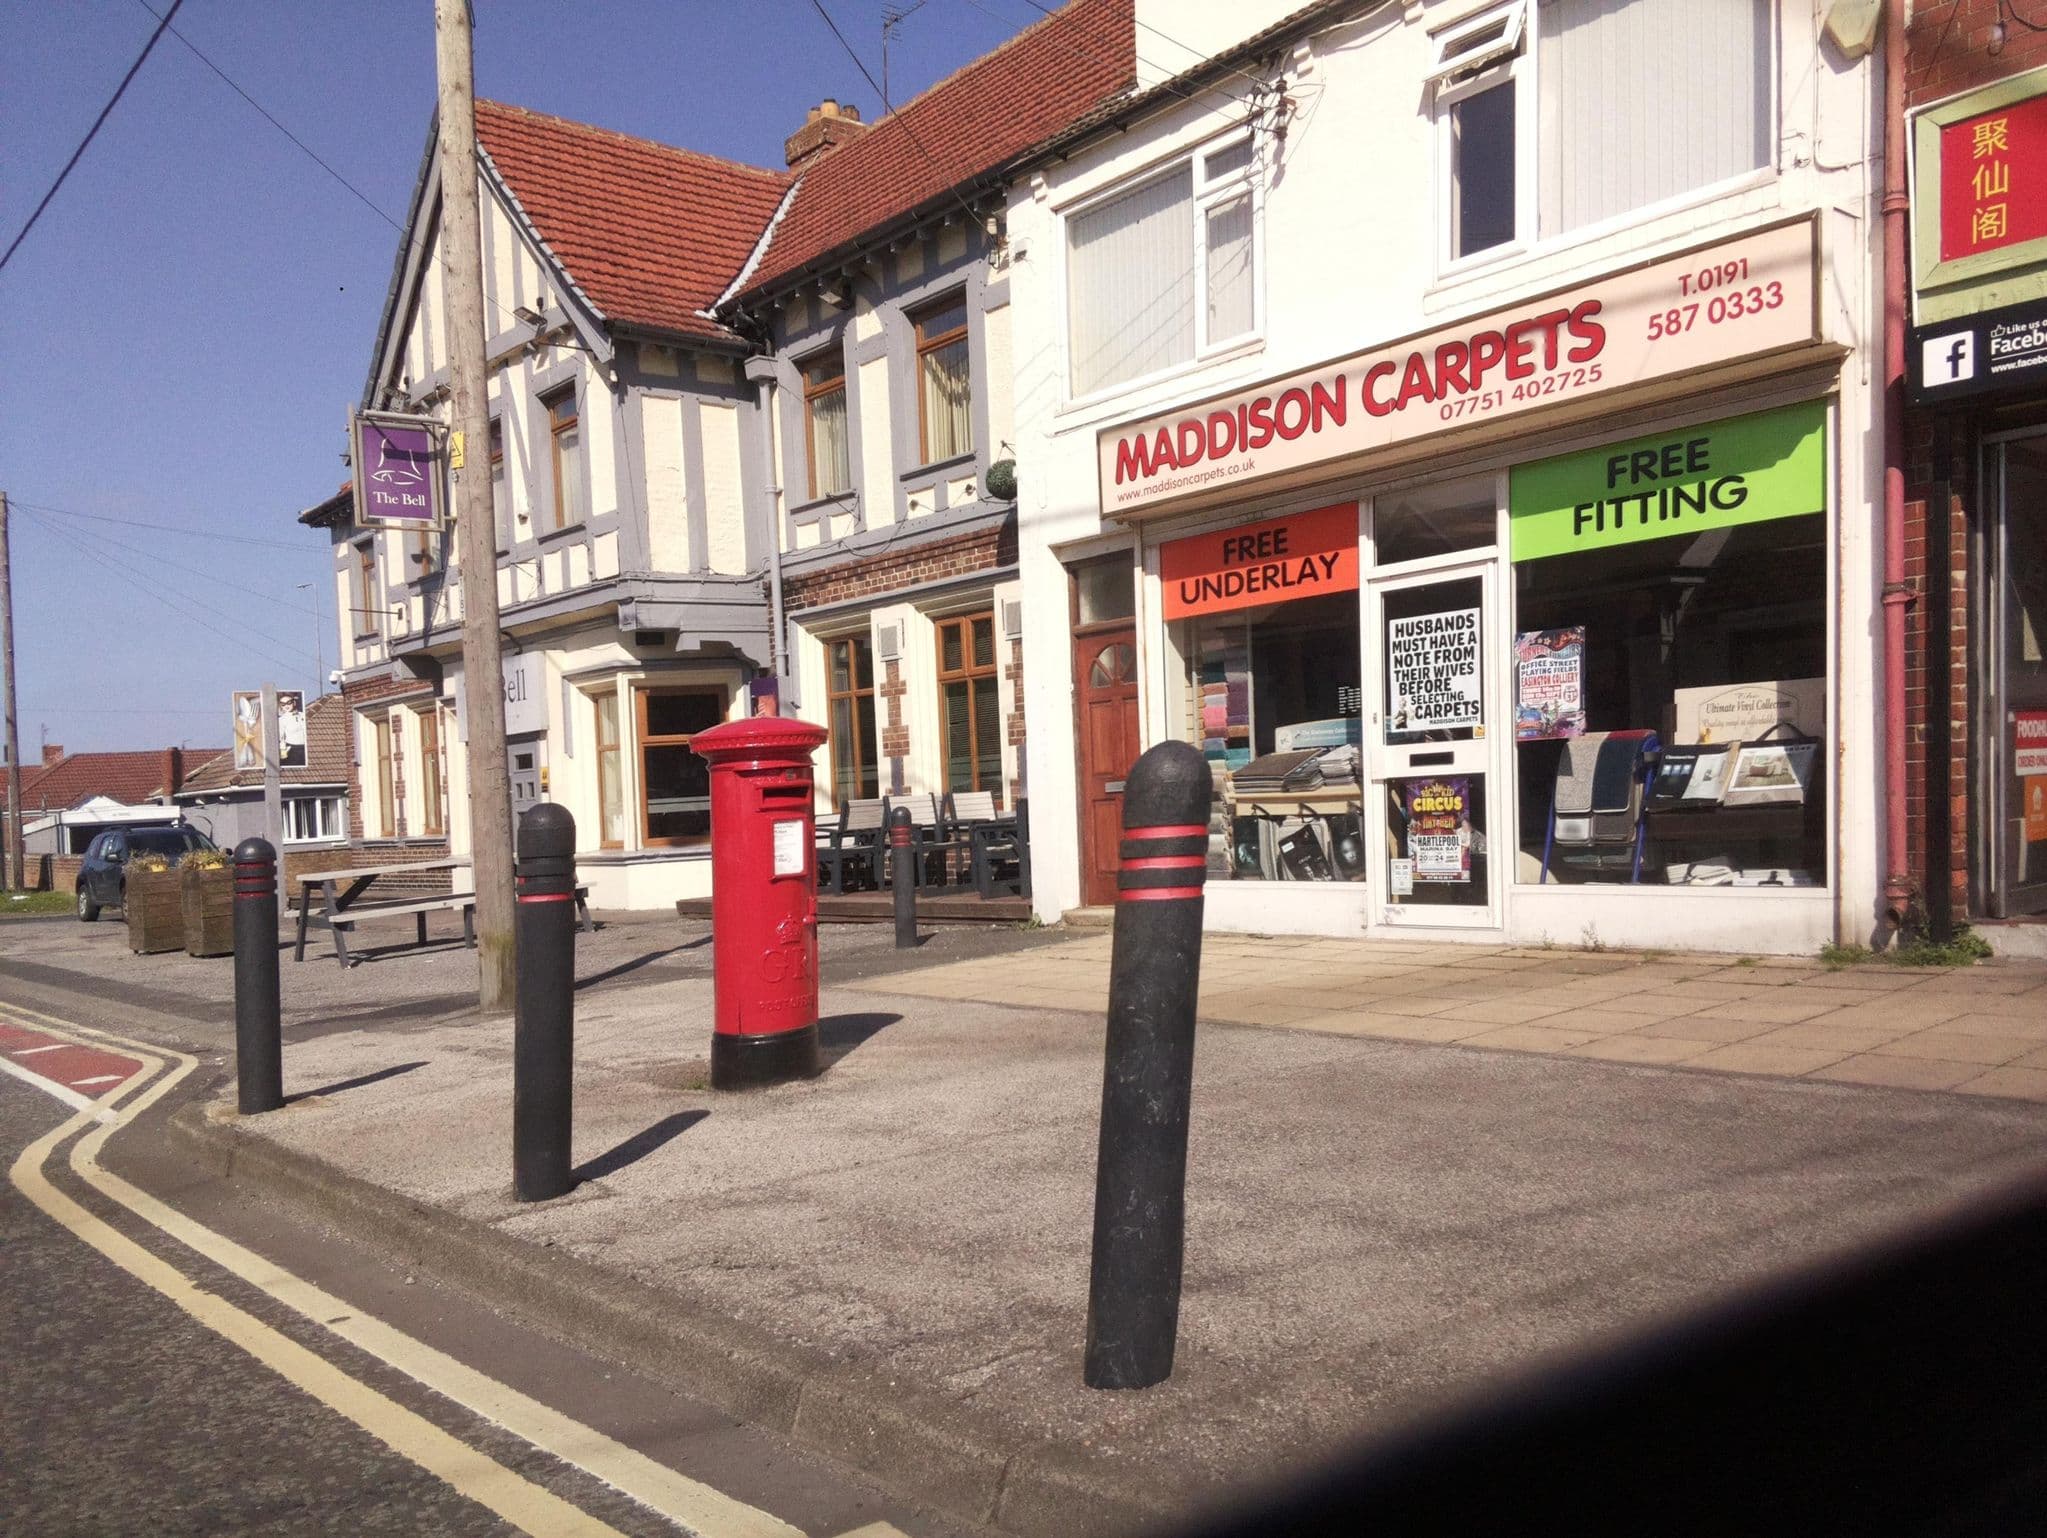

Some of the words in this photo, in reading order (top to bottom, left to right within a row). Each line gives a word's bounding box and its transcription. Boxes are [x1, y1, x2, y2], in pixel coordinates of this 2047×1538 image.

[1972, 118, 2009, 244] 聚仙阁
[1678, 257, 1748, 297] T.0191
[1646, 303, 1700, 341] 587
[1707, 281, 1784, 324] 0333
[2006, 324, 2027, 334] Like
[2029, 320, 2040, 329] us
[1991, 329, 2047, 355] Faceb
[1115, 375, 1347, 485] MADDISON
[1362, 299, 1606, 417] CARPETS
[1440, 389, 1503, 421] 07751
[1512, 363, 1602, 401] 402725
[1607, 437, 1711, 489] FREE
[1117, 458, 1256, 503] www.maddisoncarpets.co.uk
[372, 491, 399, 505] The
[402, 493, 426, 506] Bell
[1573, 475, 1748, 536] FITTING
[1223, 527, 1289, 565] FREE
[1180, 552, 1340, 605] UNDERLAY
[1395, 613, 1475, 638] HUSBANDS
[1392, 637, 1427, 654] MUST
[1430, 632, 1465, 649] HAVE
[1468, 631, 1477, 645] A
[1394, 651, 1431, 669] NOTE
[1434, 646, 1475, 664] FROM
[1521, 661, 1547, 670] OFFICE
[1394, 667, 1430, 682] THEIR
[1433, 662, 1475, 678] WIVES
[1521, 668, 1552, 676] PLAYING
[501, 669, 526, 703] ell
[1399, 677, 1452, 696] BEFORE
[1411, 691, 1464, 705] SELECTING
[1415, 700, 1480, 720] CARPETS
[1706, 702, 1736, 714] Ultimate
[1737, 700, 1755, 712] Vinyl
[1412, 796, 1463, 812] CIRCUS
[1417, 836, 1460, 847] HARTLEPOOL
